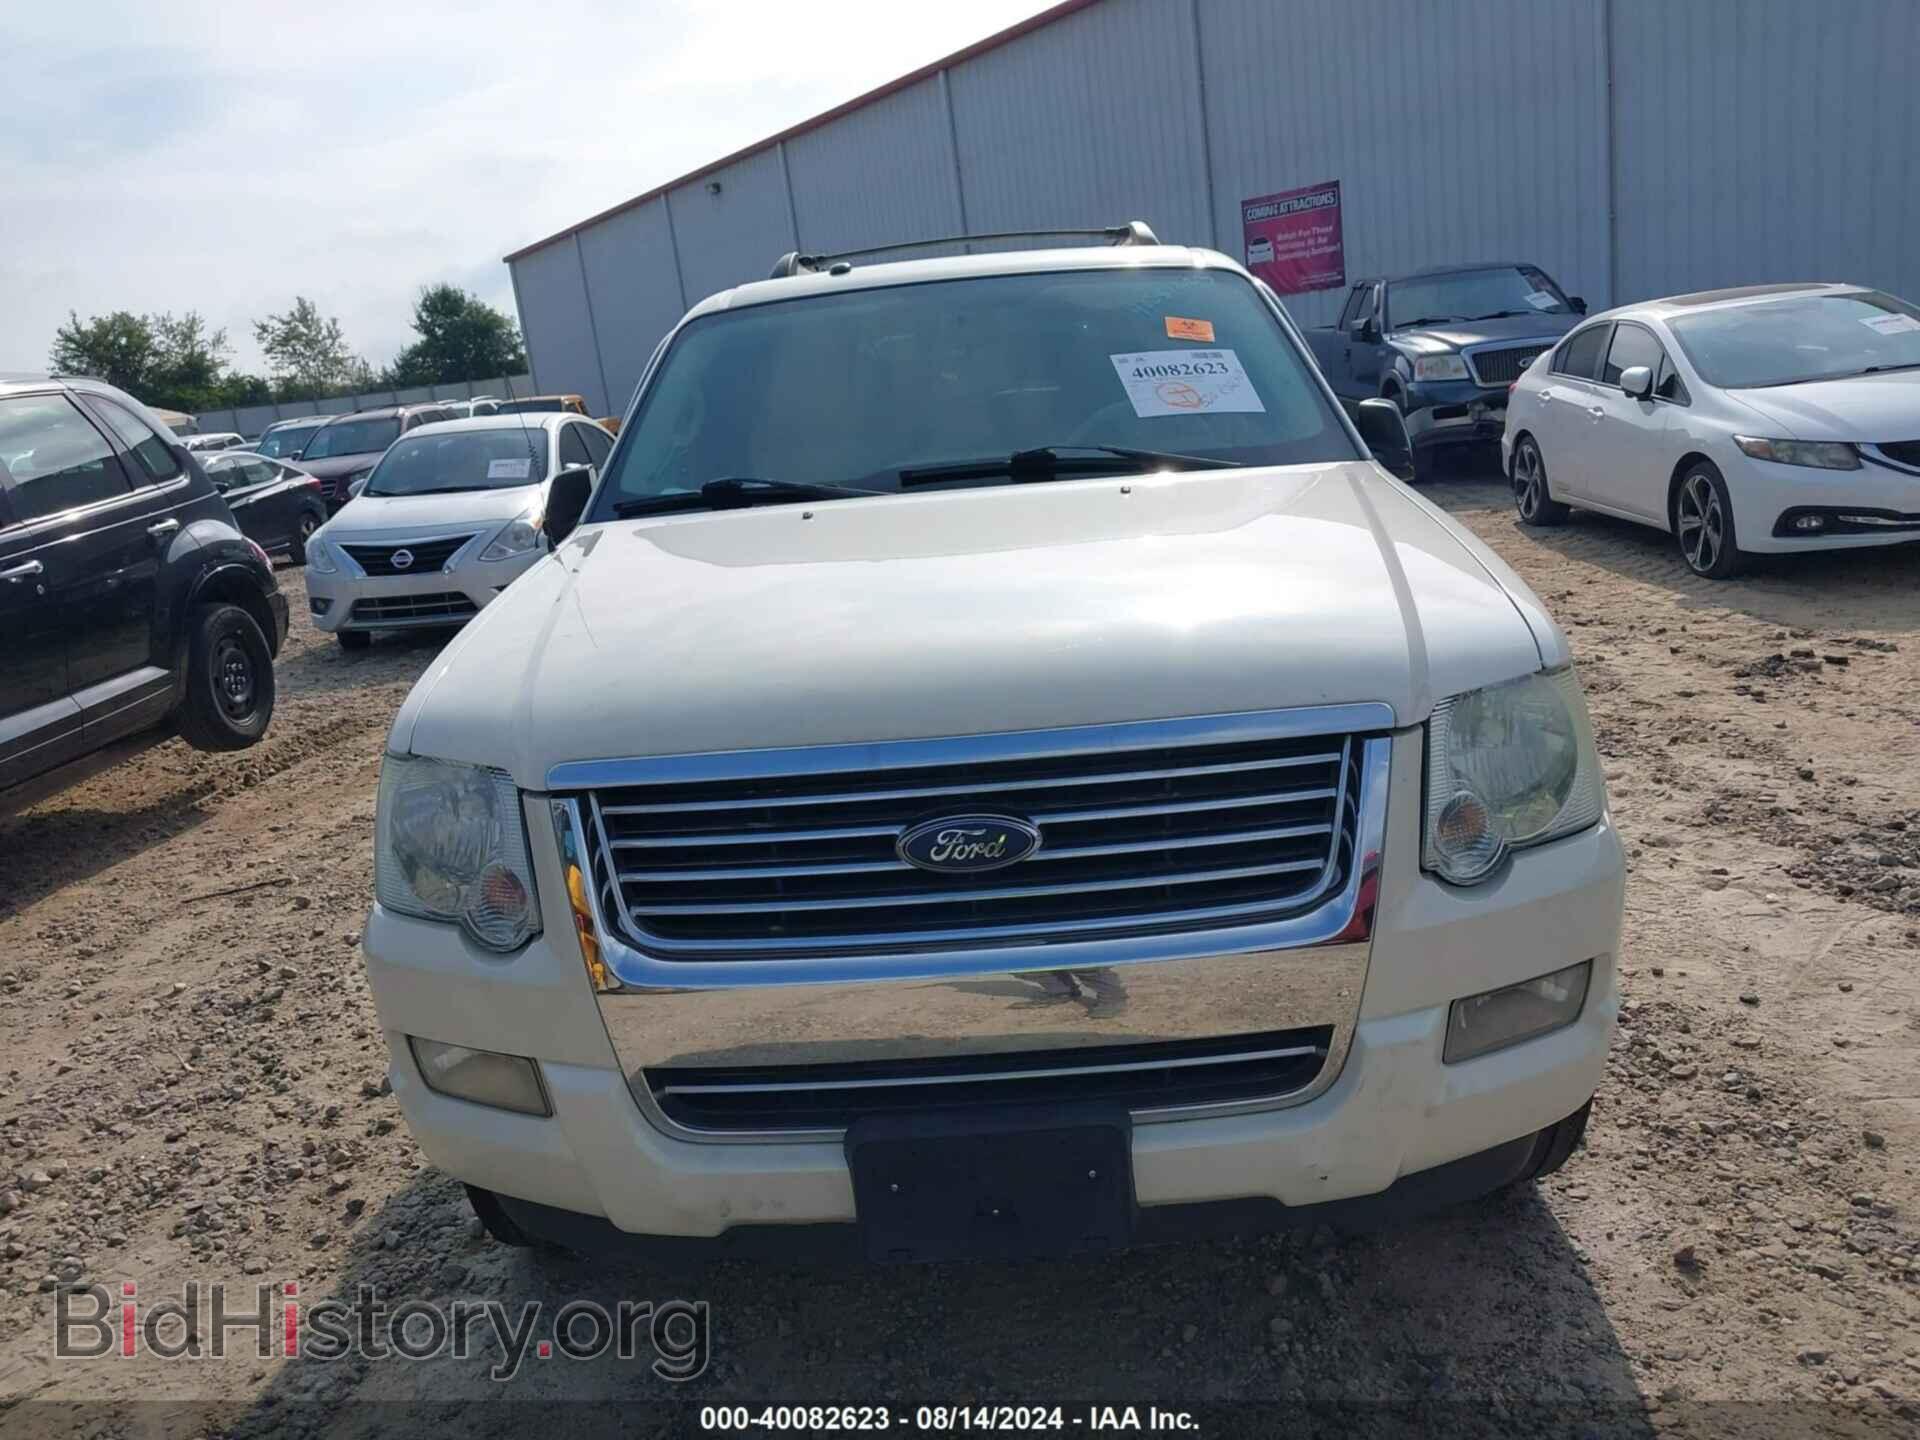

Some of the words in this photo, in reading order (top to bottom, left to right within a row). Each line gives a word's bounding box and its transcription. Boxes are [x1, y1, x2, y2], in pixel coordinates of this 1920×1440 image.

[1280, 191, 1335, 216] ATTRACTIONS
[1132, 362, 1229, 379] 40082623
[930, 828, 1008, 862] Ford
